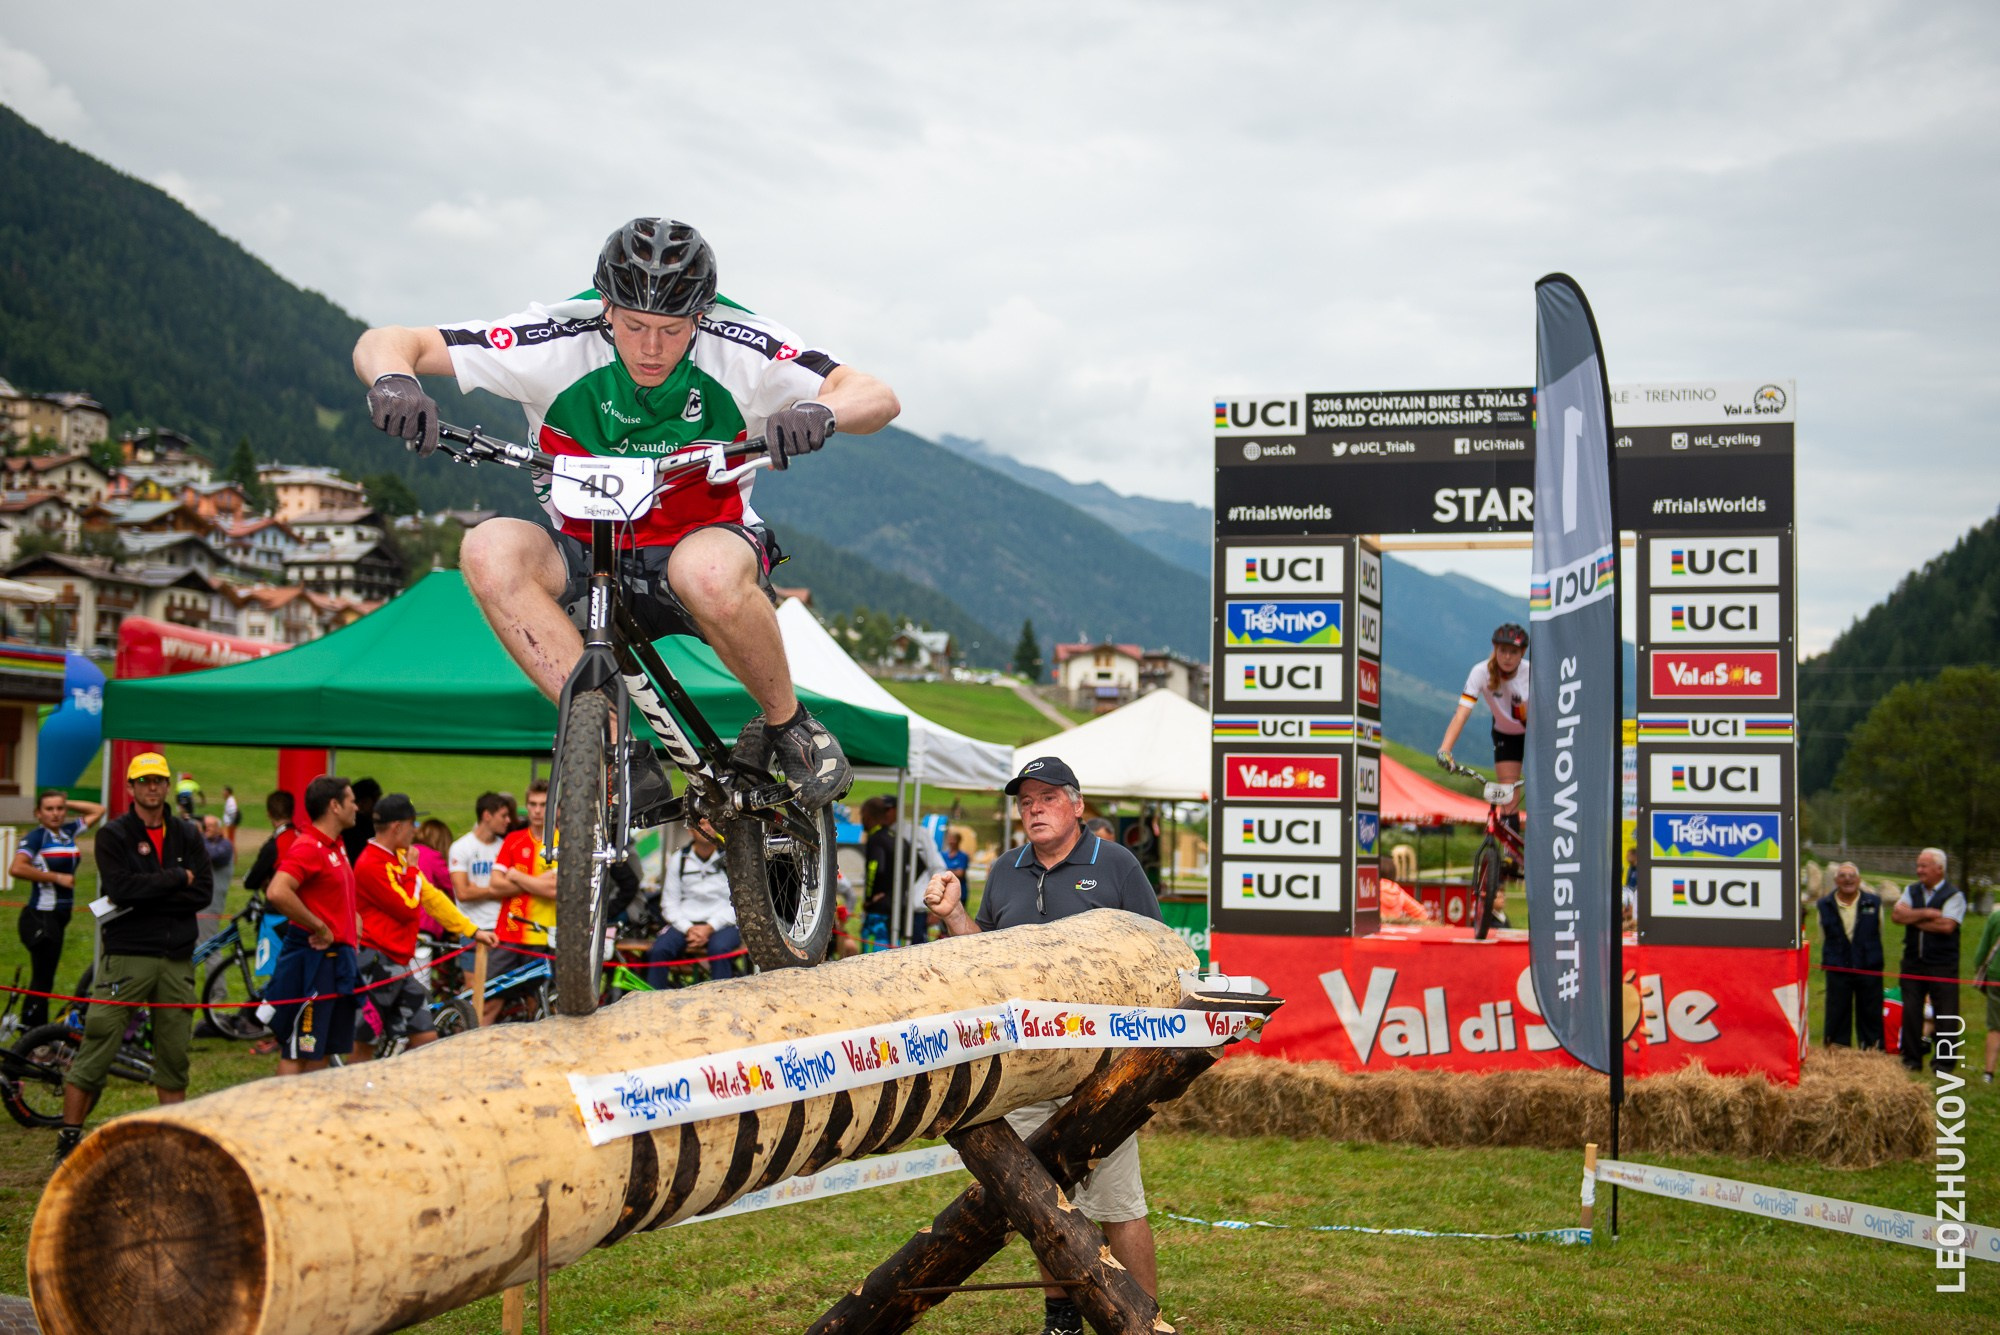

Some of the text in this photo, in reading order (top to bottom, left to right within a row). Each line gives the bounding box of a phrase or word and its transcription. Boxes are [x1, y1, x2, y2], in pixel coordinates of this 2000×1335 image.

[1312, 393, 1527, 413] 2016 MOUNTAIN BIKE & TRIALS
[1645, 388, 1716, 403] TRENTINO
[1230, 401, 1298, 428] UCI
[1312, 412, 1367, 428] WORLD
[1369, 409, 1492, 427] CHAMPIONSHIPS
[1723, 404, 1742, 417] Val
[1754, 404, 1782, 415] Sole
[631, 440, 684, 454] vaudoi
[1263, 444, 1296, 457] uci.ch
[1350, 441, 1415, 456] @UCI_Trials
[1694, 433, 1761, 448] uci_cycling
[579, 474, 624, 499] 4D
[1227, 504, 1332, 521] #TrialsWorlds
[1433, 487, 1534, 523] STAR
[1652, 497, 1766, 515] #TrialsWorlds
[1260, 558, 1324, 582] UCI
[1687, 549, 1758, 575] UCI
[1365, 561, 1377, 591] UCI
[1241, 608, 1327, 634] TRENTINO
[1365, 614, 1377, 644] UCI
[1687, 605, 1758, 631] UCI
[1259, 665, 1323, 690] UCI
[1667, 661, 1762, 687] Val di Sole
[1261, 720, 1304, 737] UCI
[1691, 719, 1738, 737] UCI
[1239, 764, 1325, 789] Val di Sole
[1363, 768, 1375, 793] UCI
[1688, 766, 1759, 792] UCI
[1257, 819, 1321, 845] UCI
[1668, 818, 1763, 847] TRENTINO
[1257, 874, 1320, 900] UCI
[1689, 879, 1760, 907] UCI
[1041, 1019, 1053, 1035] di
[1055, 1011, 1096, 1037] Sole
[1109, 1011, 1186, 1042] TRENTINO
[1205, 1011, 1230, 1037] Val
[1317, 966, 1450, 1065] Val
[1459, 999, 1517, 1053] di
[614, 1077, 691, 1121] TRENTINO
[701, 1066, 731, 1100] Val
[738, 1061, 775, 1096] Sole
[775, 1050, 836, 1092] TRENTINO
[842, 1038, 866, 1075] Val
[870, 1036, 900, 1070] Sole
[900, 1027, 949, 1067] TRENTINO
[953, 1018, 972, 1051] Val
